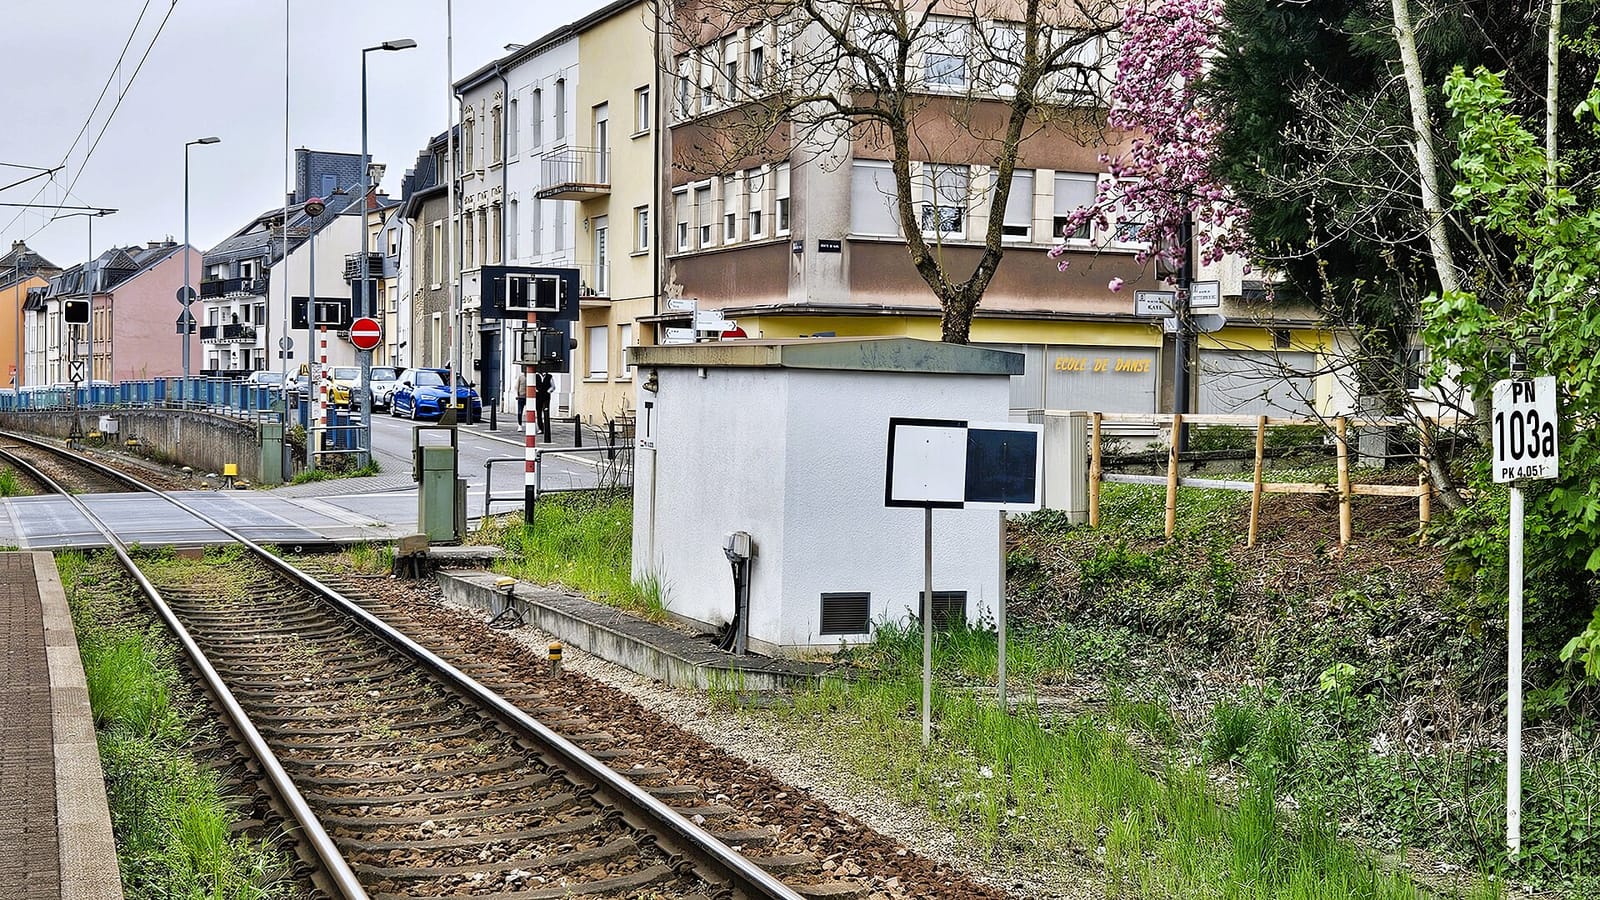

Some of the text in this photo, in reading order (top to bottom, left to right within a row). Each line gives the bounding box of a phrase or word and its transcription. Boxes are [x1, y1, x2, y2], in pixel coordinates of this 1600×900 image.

[1055, 357, 1152, 372] ECOLE DE DANSE
[1512, 381, 1536, 404] PN
[1495, 409, 1555, 461] 103a
[1502, 465, 1543, 479] PK 4.051
